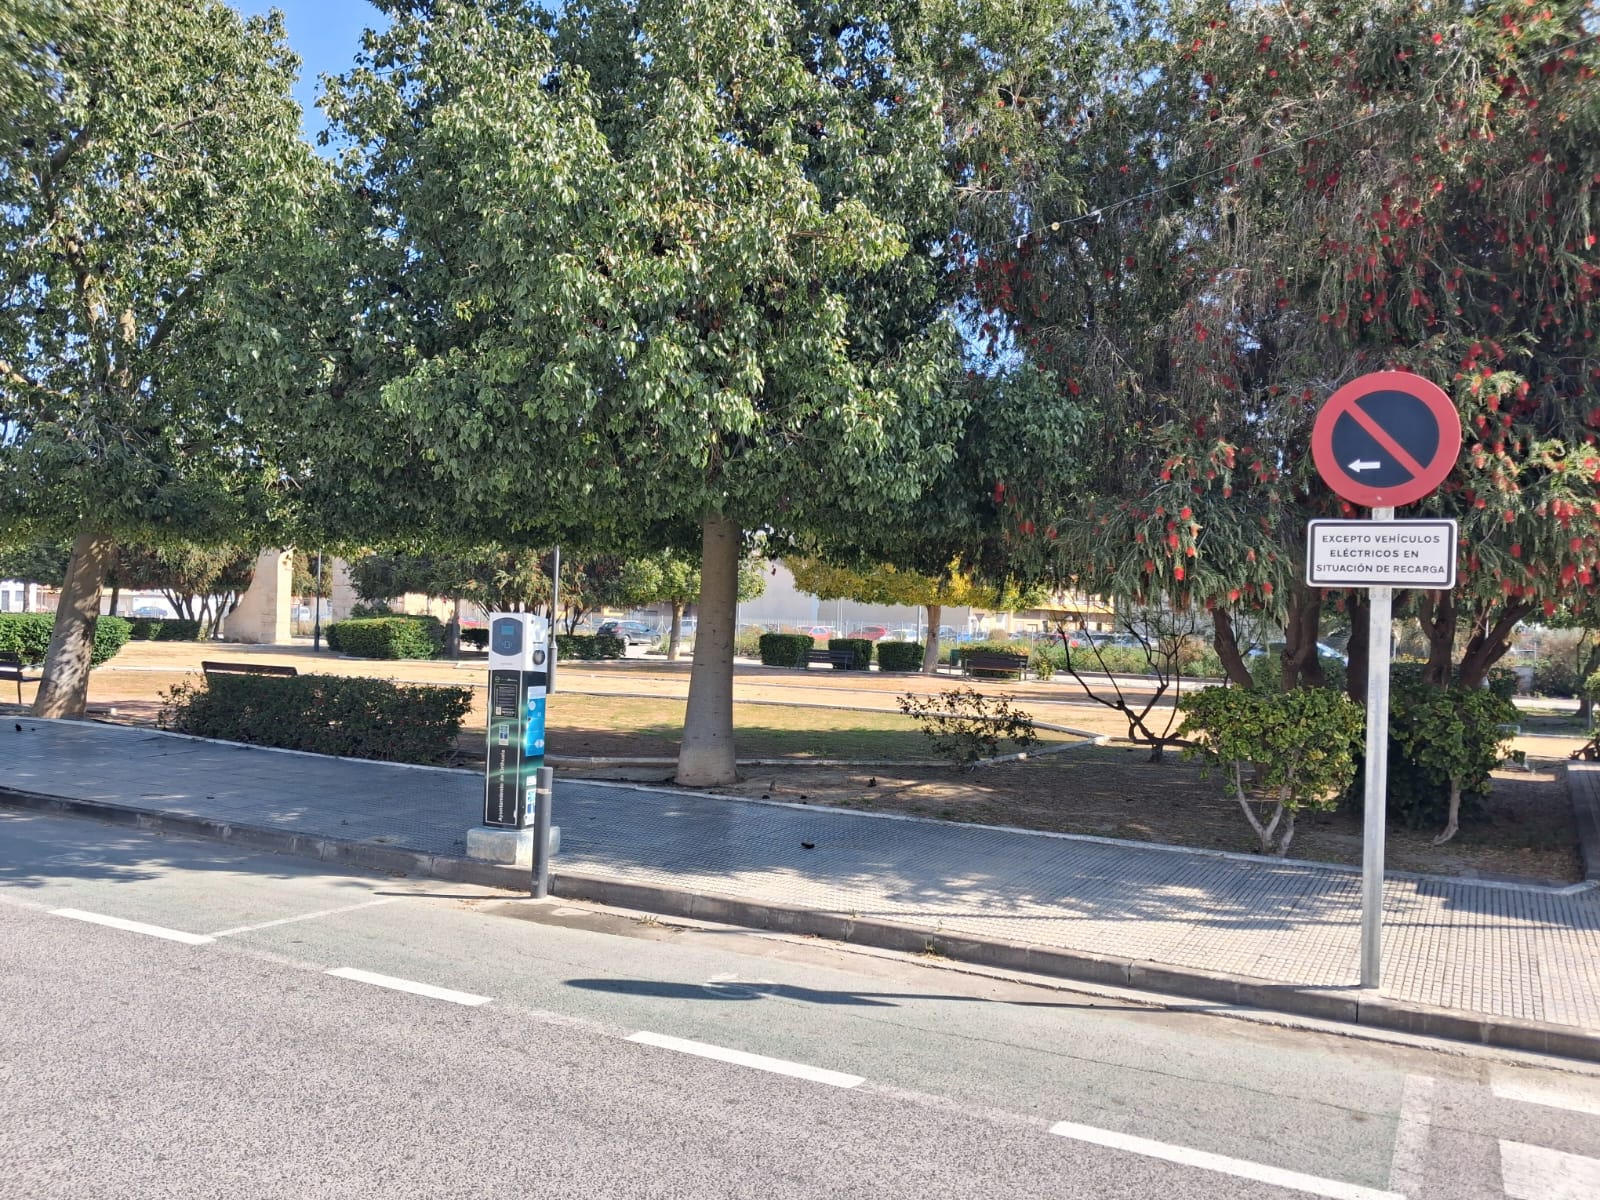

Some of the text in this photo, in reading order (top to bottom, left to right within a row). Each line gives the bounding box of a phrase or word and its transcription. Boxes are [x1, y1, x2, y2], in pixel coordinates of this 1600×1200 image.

[1322, 533, 1440, 543] EXCEPTO VEHÍCULOS
[1330, 548, 1419, 558] ELÉCTRICOS EN
[1316, 563, 1445, 574] SITUACIÓN DE RECARGA
